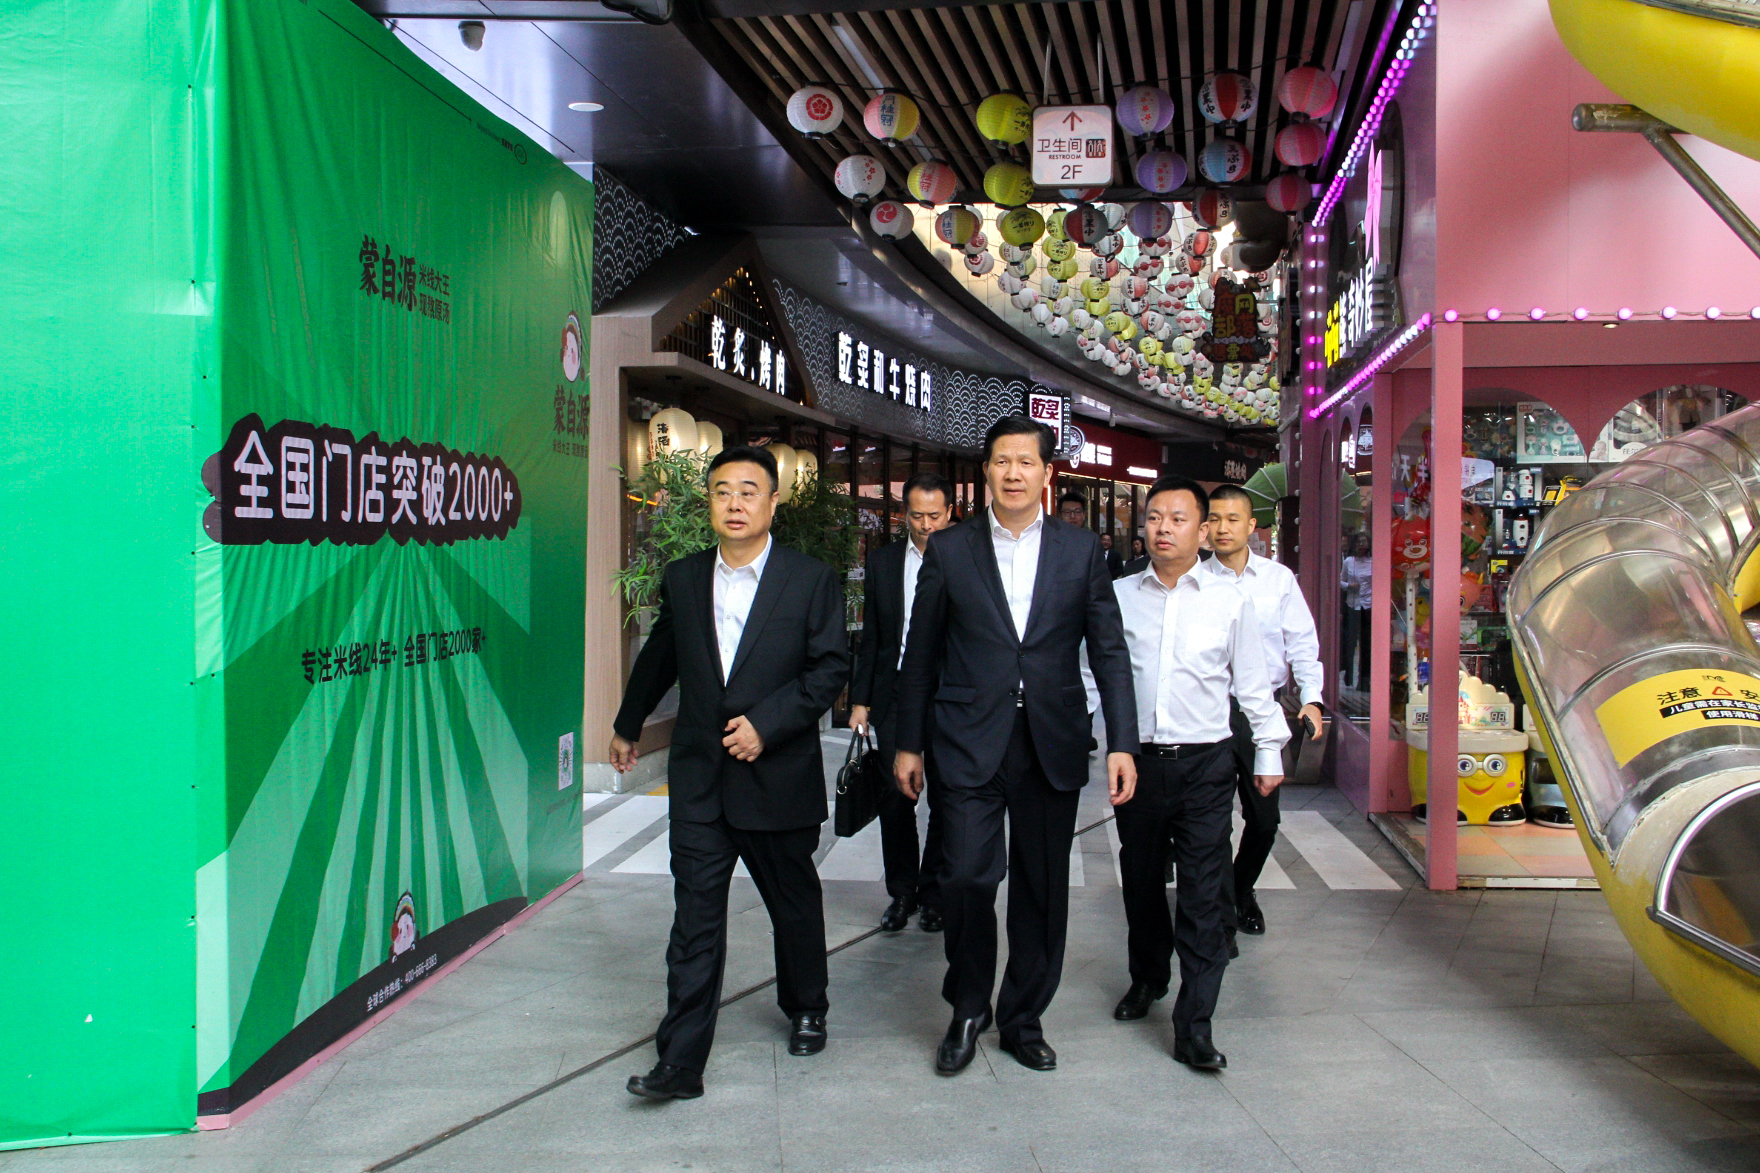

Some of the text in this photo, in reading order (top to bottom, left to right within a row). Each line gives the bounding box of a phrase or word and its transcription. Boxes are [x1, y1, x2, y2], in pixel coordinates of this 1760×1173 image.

[1037, 138, 1082, 153] 卫生间
[1061, 165, 1083, 180] 2F
[359, 233, 418, 312] 蒙自源
[419, 264, 450, 296] 米线大王
[553, 384, 589, 440] 蒙自源
[234, 430, 514, 526] 全国门店突破2000+
[302, 627, 486, 685] 专注米线24年+ 全国门店2000家+
[1657, 687, 1702, 705] 注意
[1706, 710, 1759, 720] 使用滑梯
